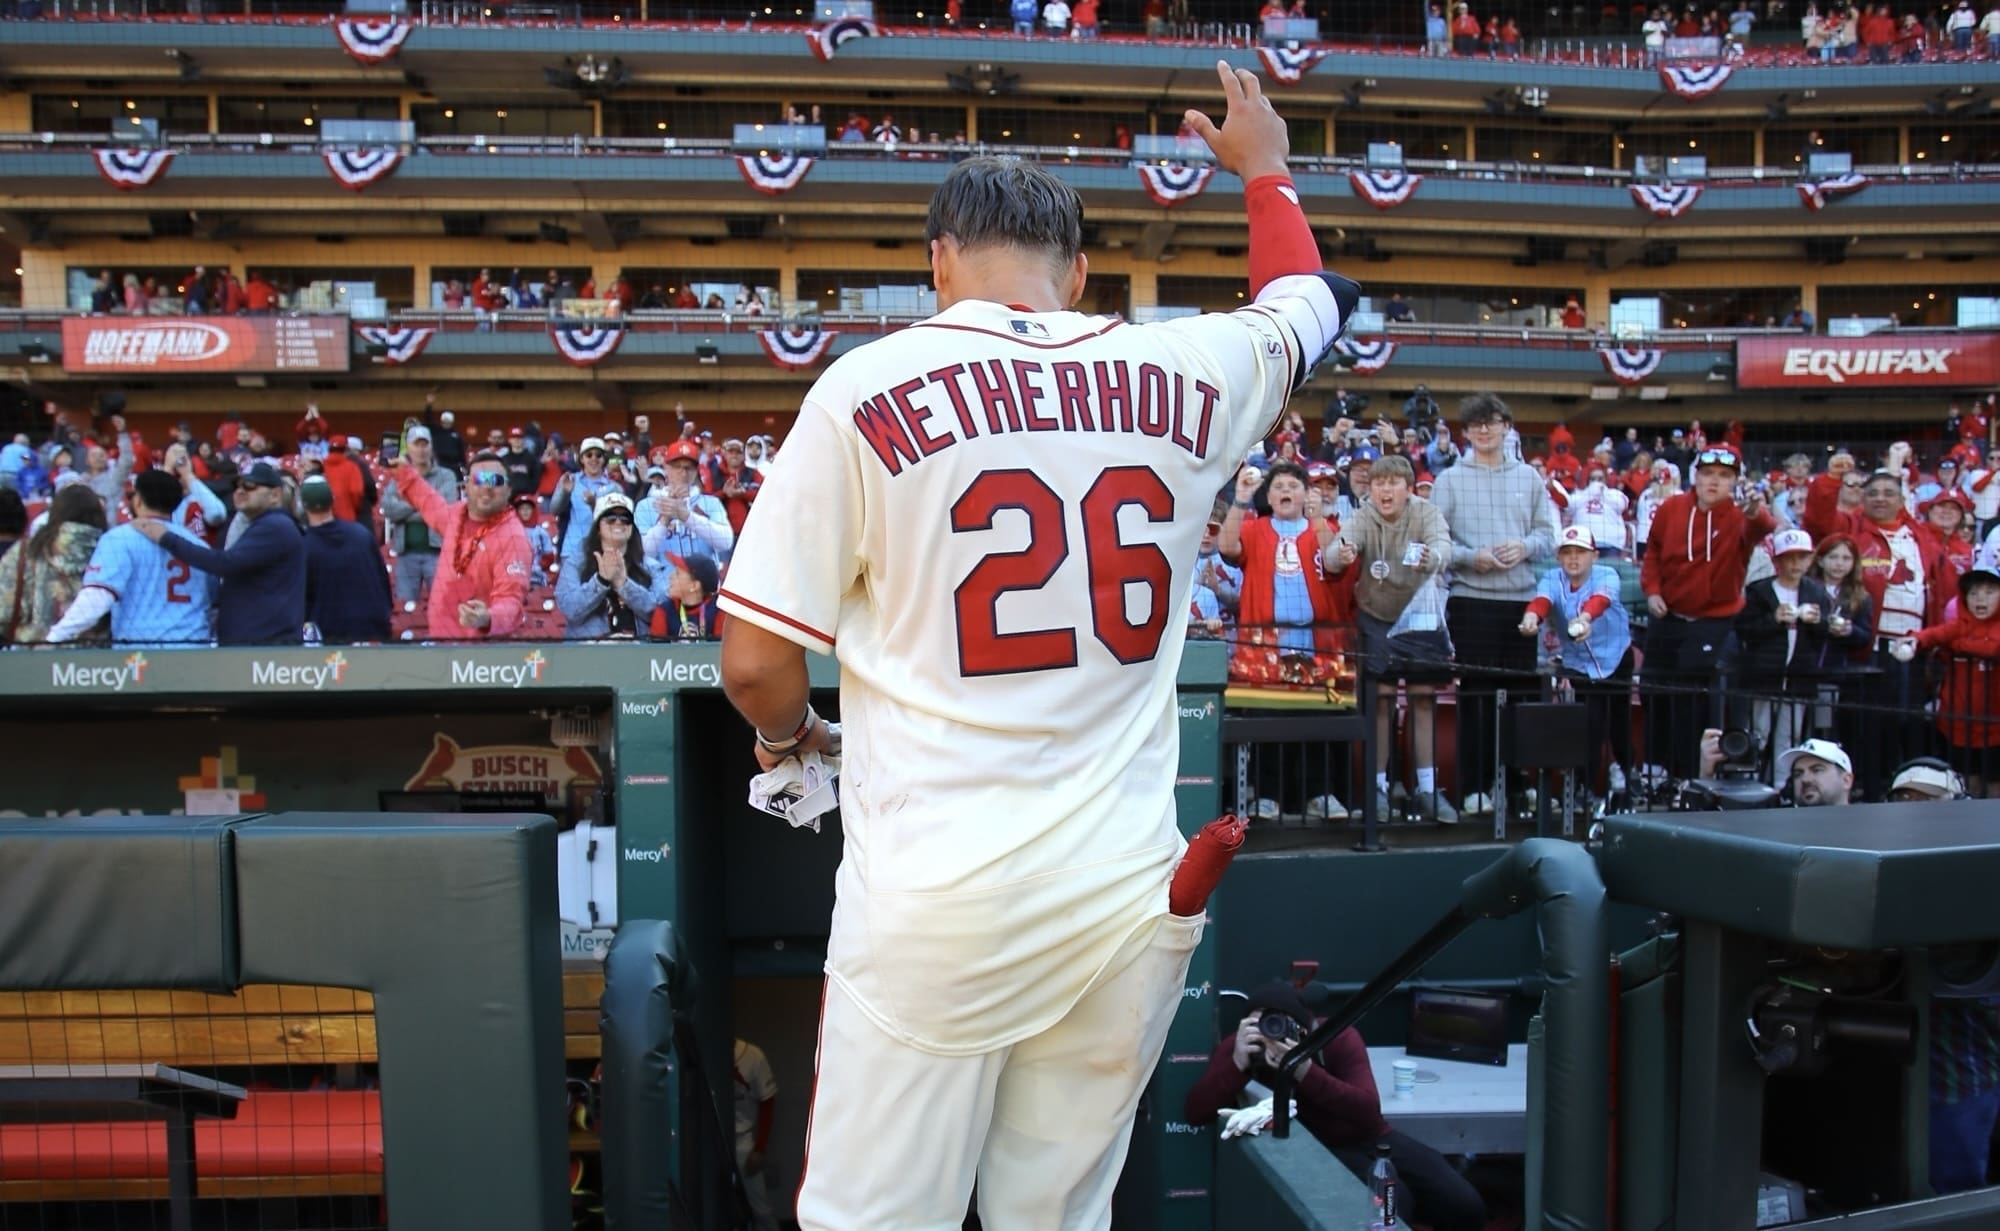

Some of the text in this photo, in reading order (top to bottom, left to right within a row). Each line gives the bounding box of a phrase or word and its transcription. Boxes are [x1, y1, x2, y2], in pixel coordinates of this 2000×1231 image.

[85, 329, 210, 356] HOFFMANN
[1783, 347, 1952, 383] EQUIFAX
[853, 358, 1220, 477] WETHERHOLT
[166, 558, 192, 603] 2
[950, 465, 1175, 678] 26
[52, 662, 129, 691] Mercy
[252, 661, 329, 690] Mercy
[451, 660, 527, 688] Mercy
[650, 658, 721, 687] Mercy
[622, 702, 660, 717] Mercy
[1179, 706, 1206, 720] ercy
[471, 756, 549, 778] BUSCH
[624, 848, 662, 863] Mercy
[564, 934, 612, 952] Merc
